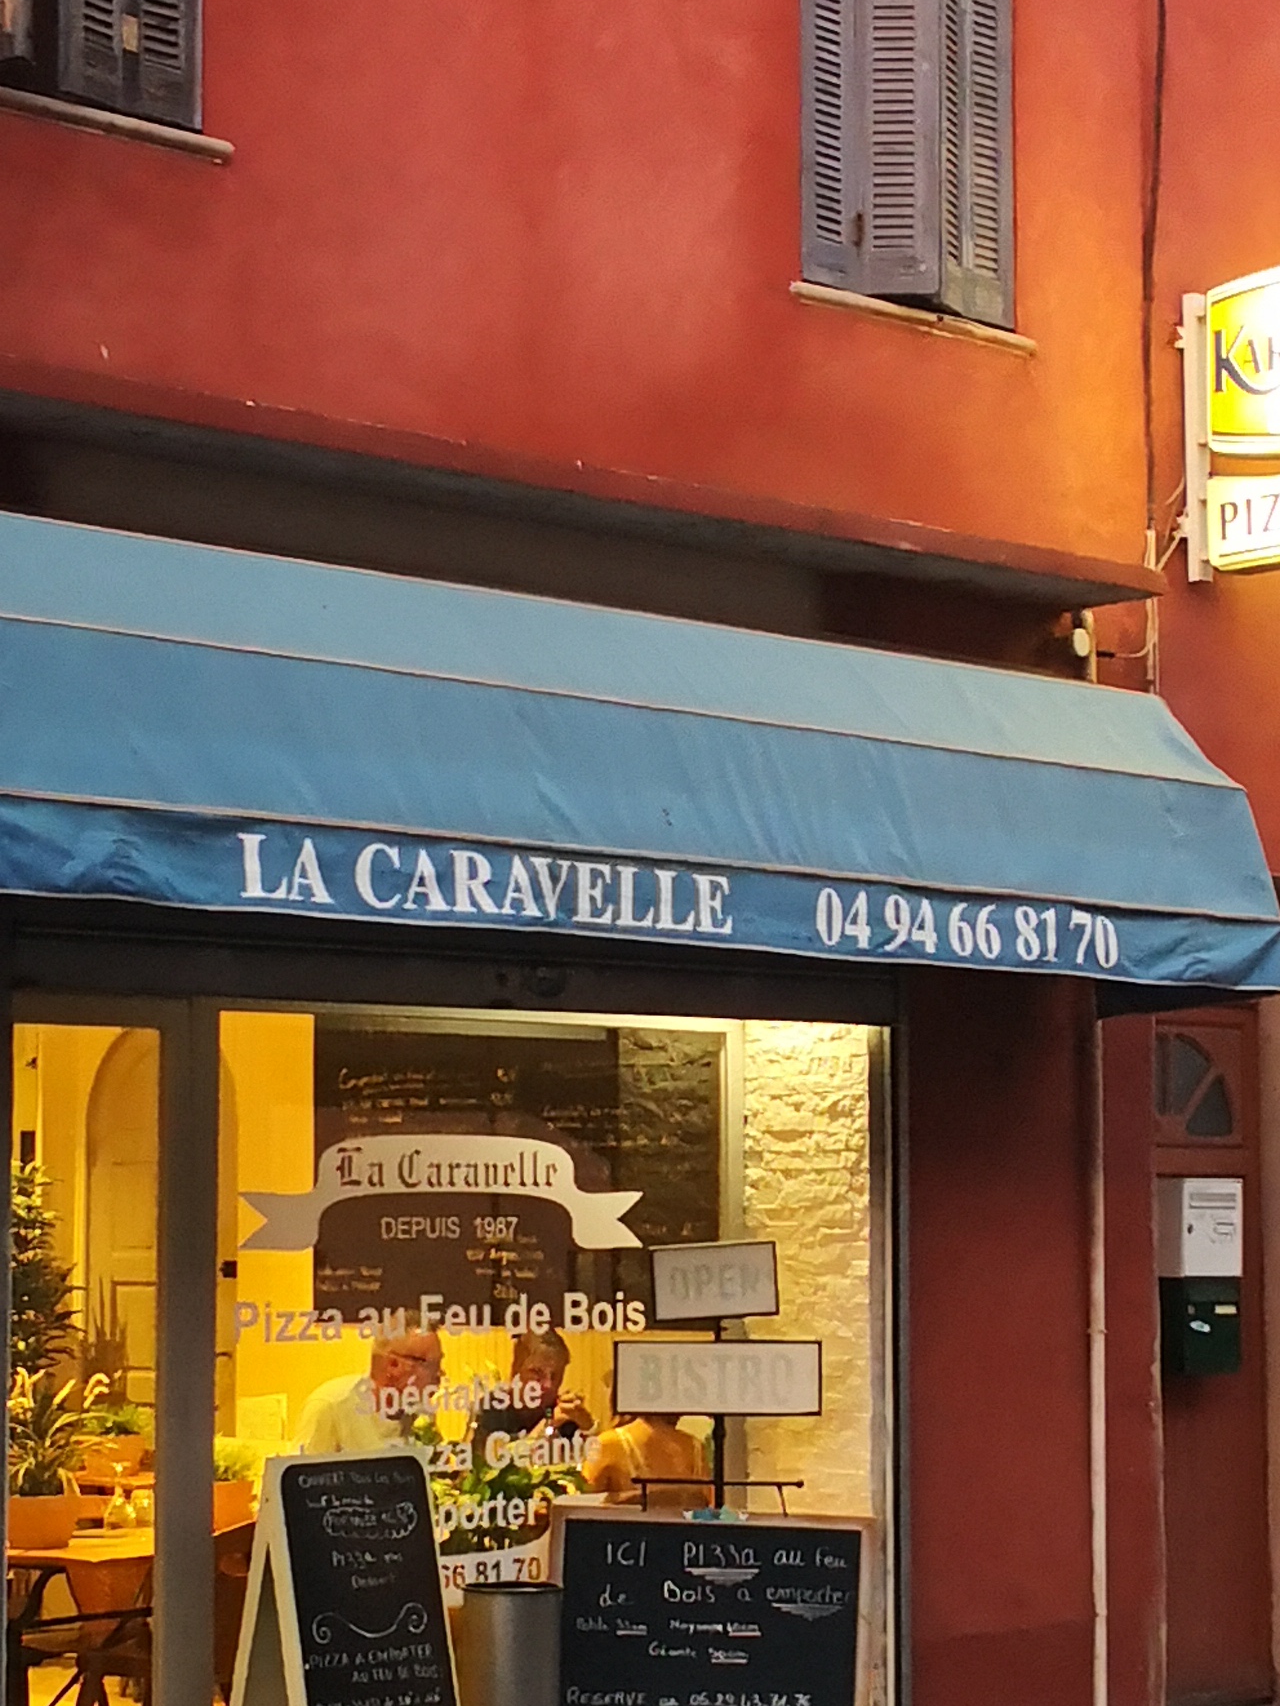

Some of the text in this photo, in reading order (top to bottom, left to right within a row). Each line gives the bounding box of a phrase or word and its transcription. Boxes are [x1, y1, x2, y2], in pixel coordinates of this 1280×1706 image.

[237, 832, 1118, 969] LA CARAVELLE 04 94 66 81 70
[336, 1146, 558, 1189] La Caravelle
[380, 1215, 519, 1240] DEPUIS 1987
[669, 1264, 763, 1301] OPEN
[234, 1291, 647, 1343] Pizza au Feu de Bois
[354, 1373, 543, 1420] Spécialiste
[637, 1353, 794, 1405] BISTRO
[485, 1429, 603, 1470] Géante
[437, 1491, 542, 1540] porter
[475, 1559, 502, 1582] 81
[512, 1557, 541, 1581] 70
[606, 1541, 647, 1567] ICI
[774, 1546, 807, 1566] au
[599, 1583, 635, 1608] de
